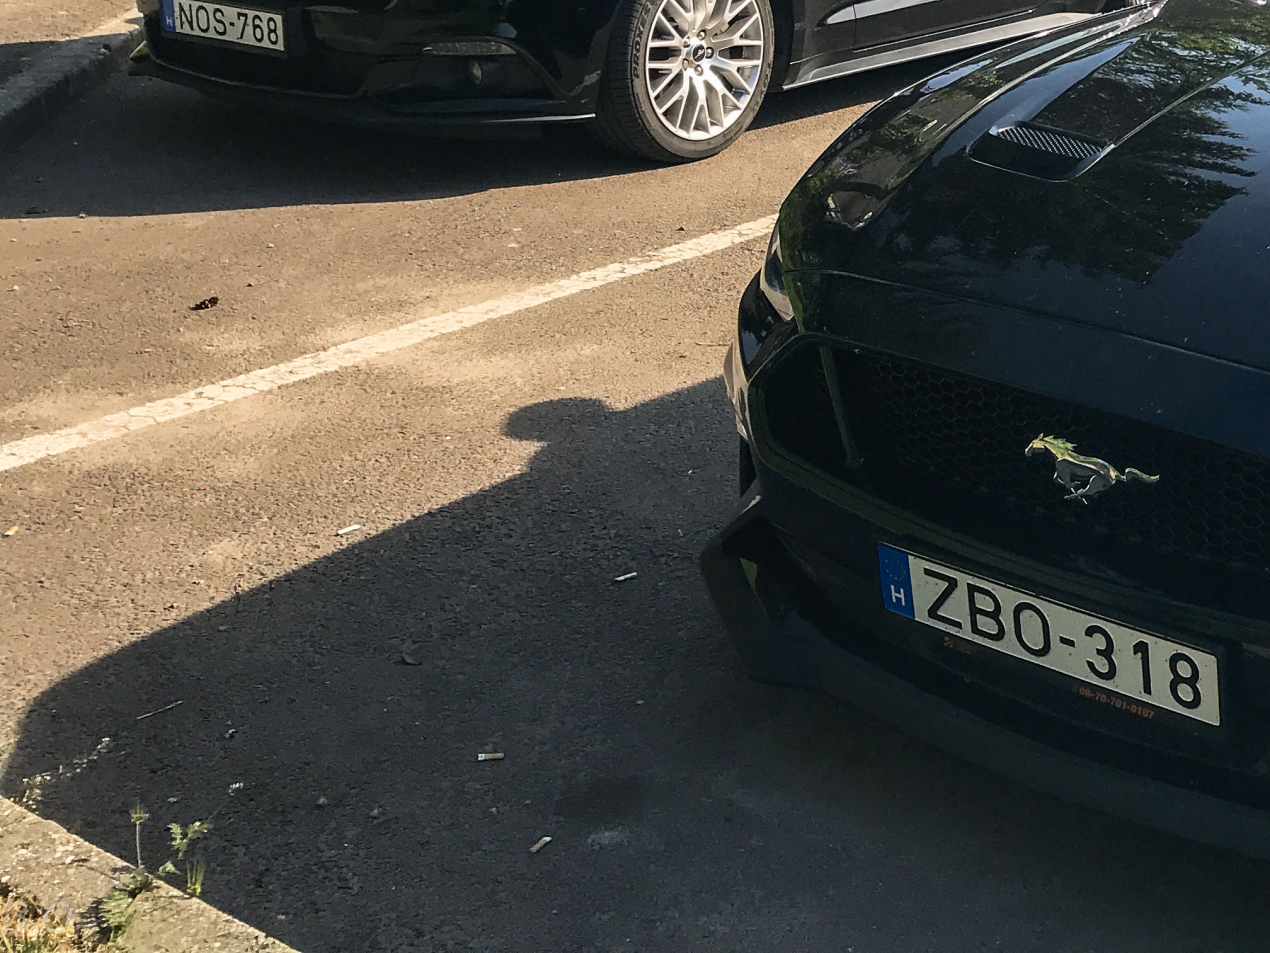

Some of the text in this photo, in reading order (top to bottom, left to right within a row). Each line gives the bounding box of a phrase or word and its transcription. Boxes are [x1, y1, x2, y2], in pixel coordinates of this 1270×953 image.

[166, 1, 279, 45] H NOS-768
[890, 567, 1202, 710] H ZBO-318
